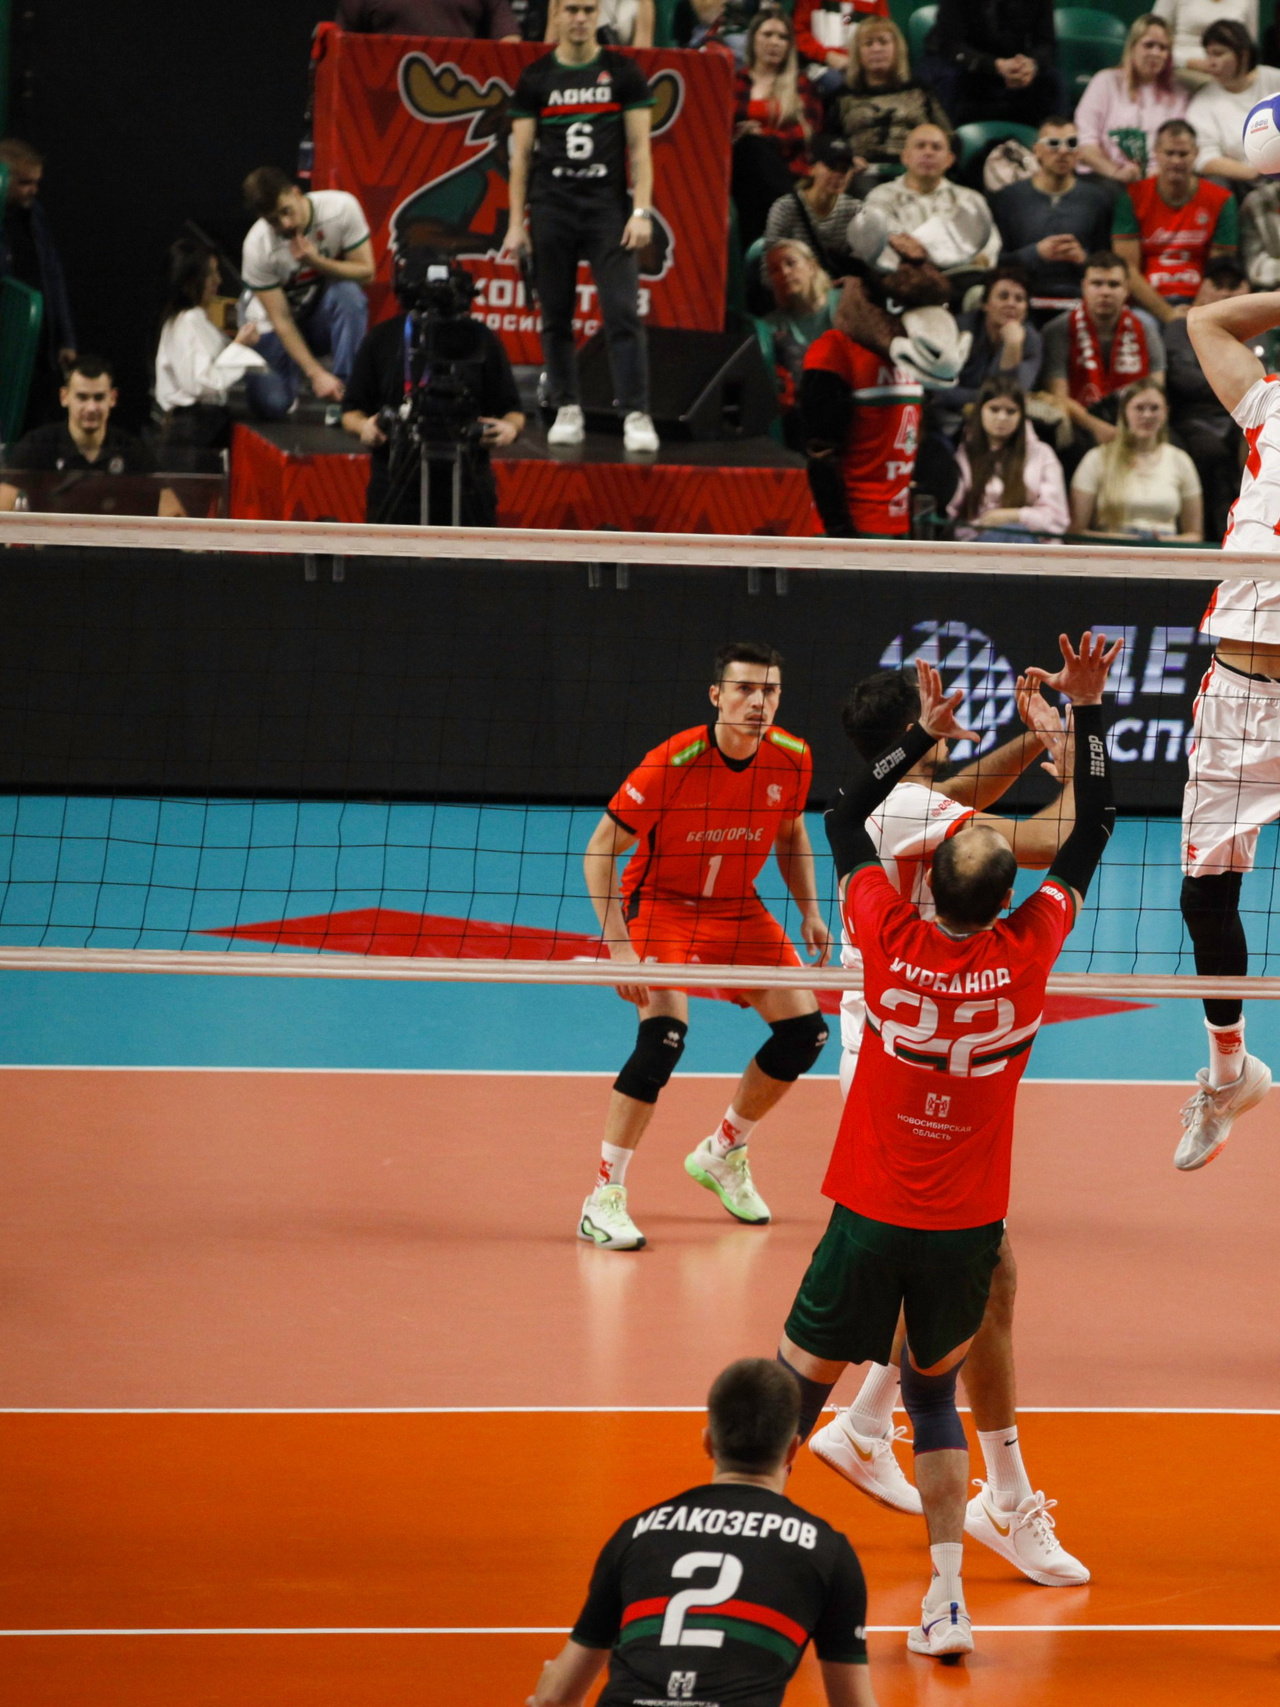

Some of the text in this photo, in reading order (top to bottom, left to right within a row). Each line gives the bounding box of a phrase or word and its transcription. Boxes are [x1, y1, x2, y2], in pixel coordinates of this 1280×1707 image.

[566, 122, 594, 160] 6
[702, 855, 723, 898] 1
[879, 987, 1016, 1078] 22
[897, 1113, 972, 1133] НОВОСИБИРСКАЯ
[912, 1127, 952, 1142] ОБЛАСТЬ
[632, 1505, 818, 1550] МЕЛКОЗЕРОВ
[660, 1551, 744, 1648] 2
